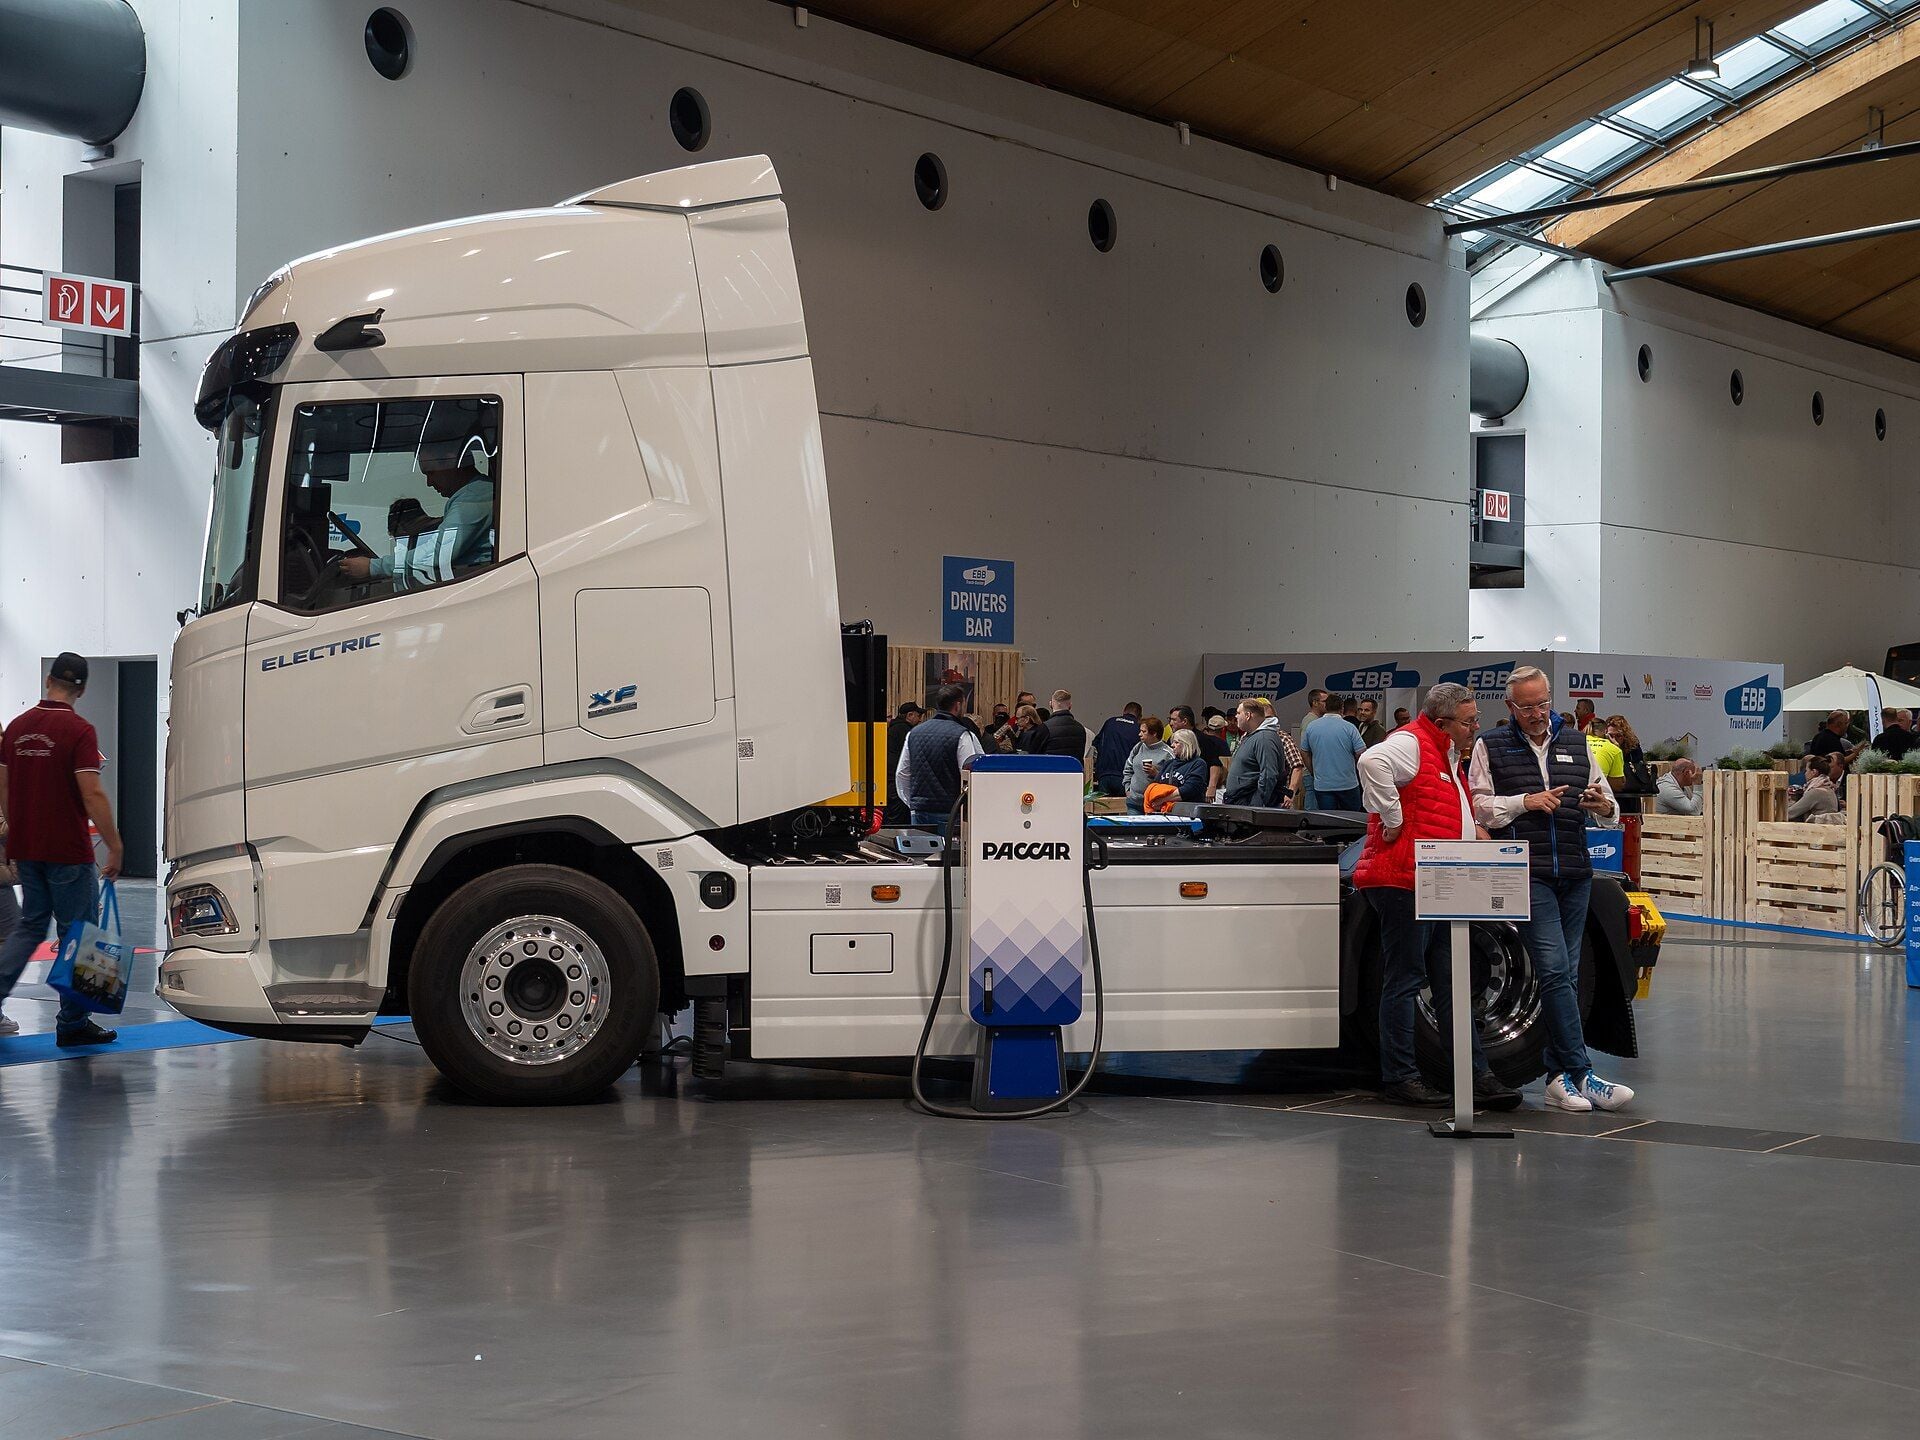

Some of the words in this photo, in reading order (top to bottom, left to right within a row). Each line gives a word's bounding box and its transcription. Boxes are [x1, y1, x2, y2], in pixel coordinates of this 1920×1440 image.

[972, 569, 987, 579] EBB
[951, 591, 1007, 613] DRIVERS
[965, 617, 993, 637] BAR
[261, 633, 382, 672] ELECTRIC
[1240, 671, 1281, 689] EBB
[1351, 671, 1393, 689] EBB
[1466, 670, 1511, 688] EBB
[1569, 672, 1604, 690] DAF
[588, 684, 639, 709] XF
[1741, 687, 1766, 712] EBB
[1729, 717, 1763, 730] Truck-Center
[982, 842, 1071, 860] PACCAR
